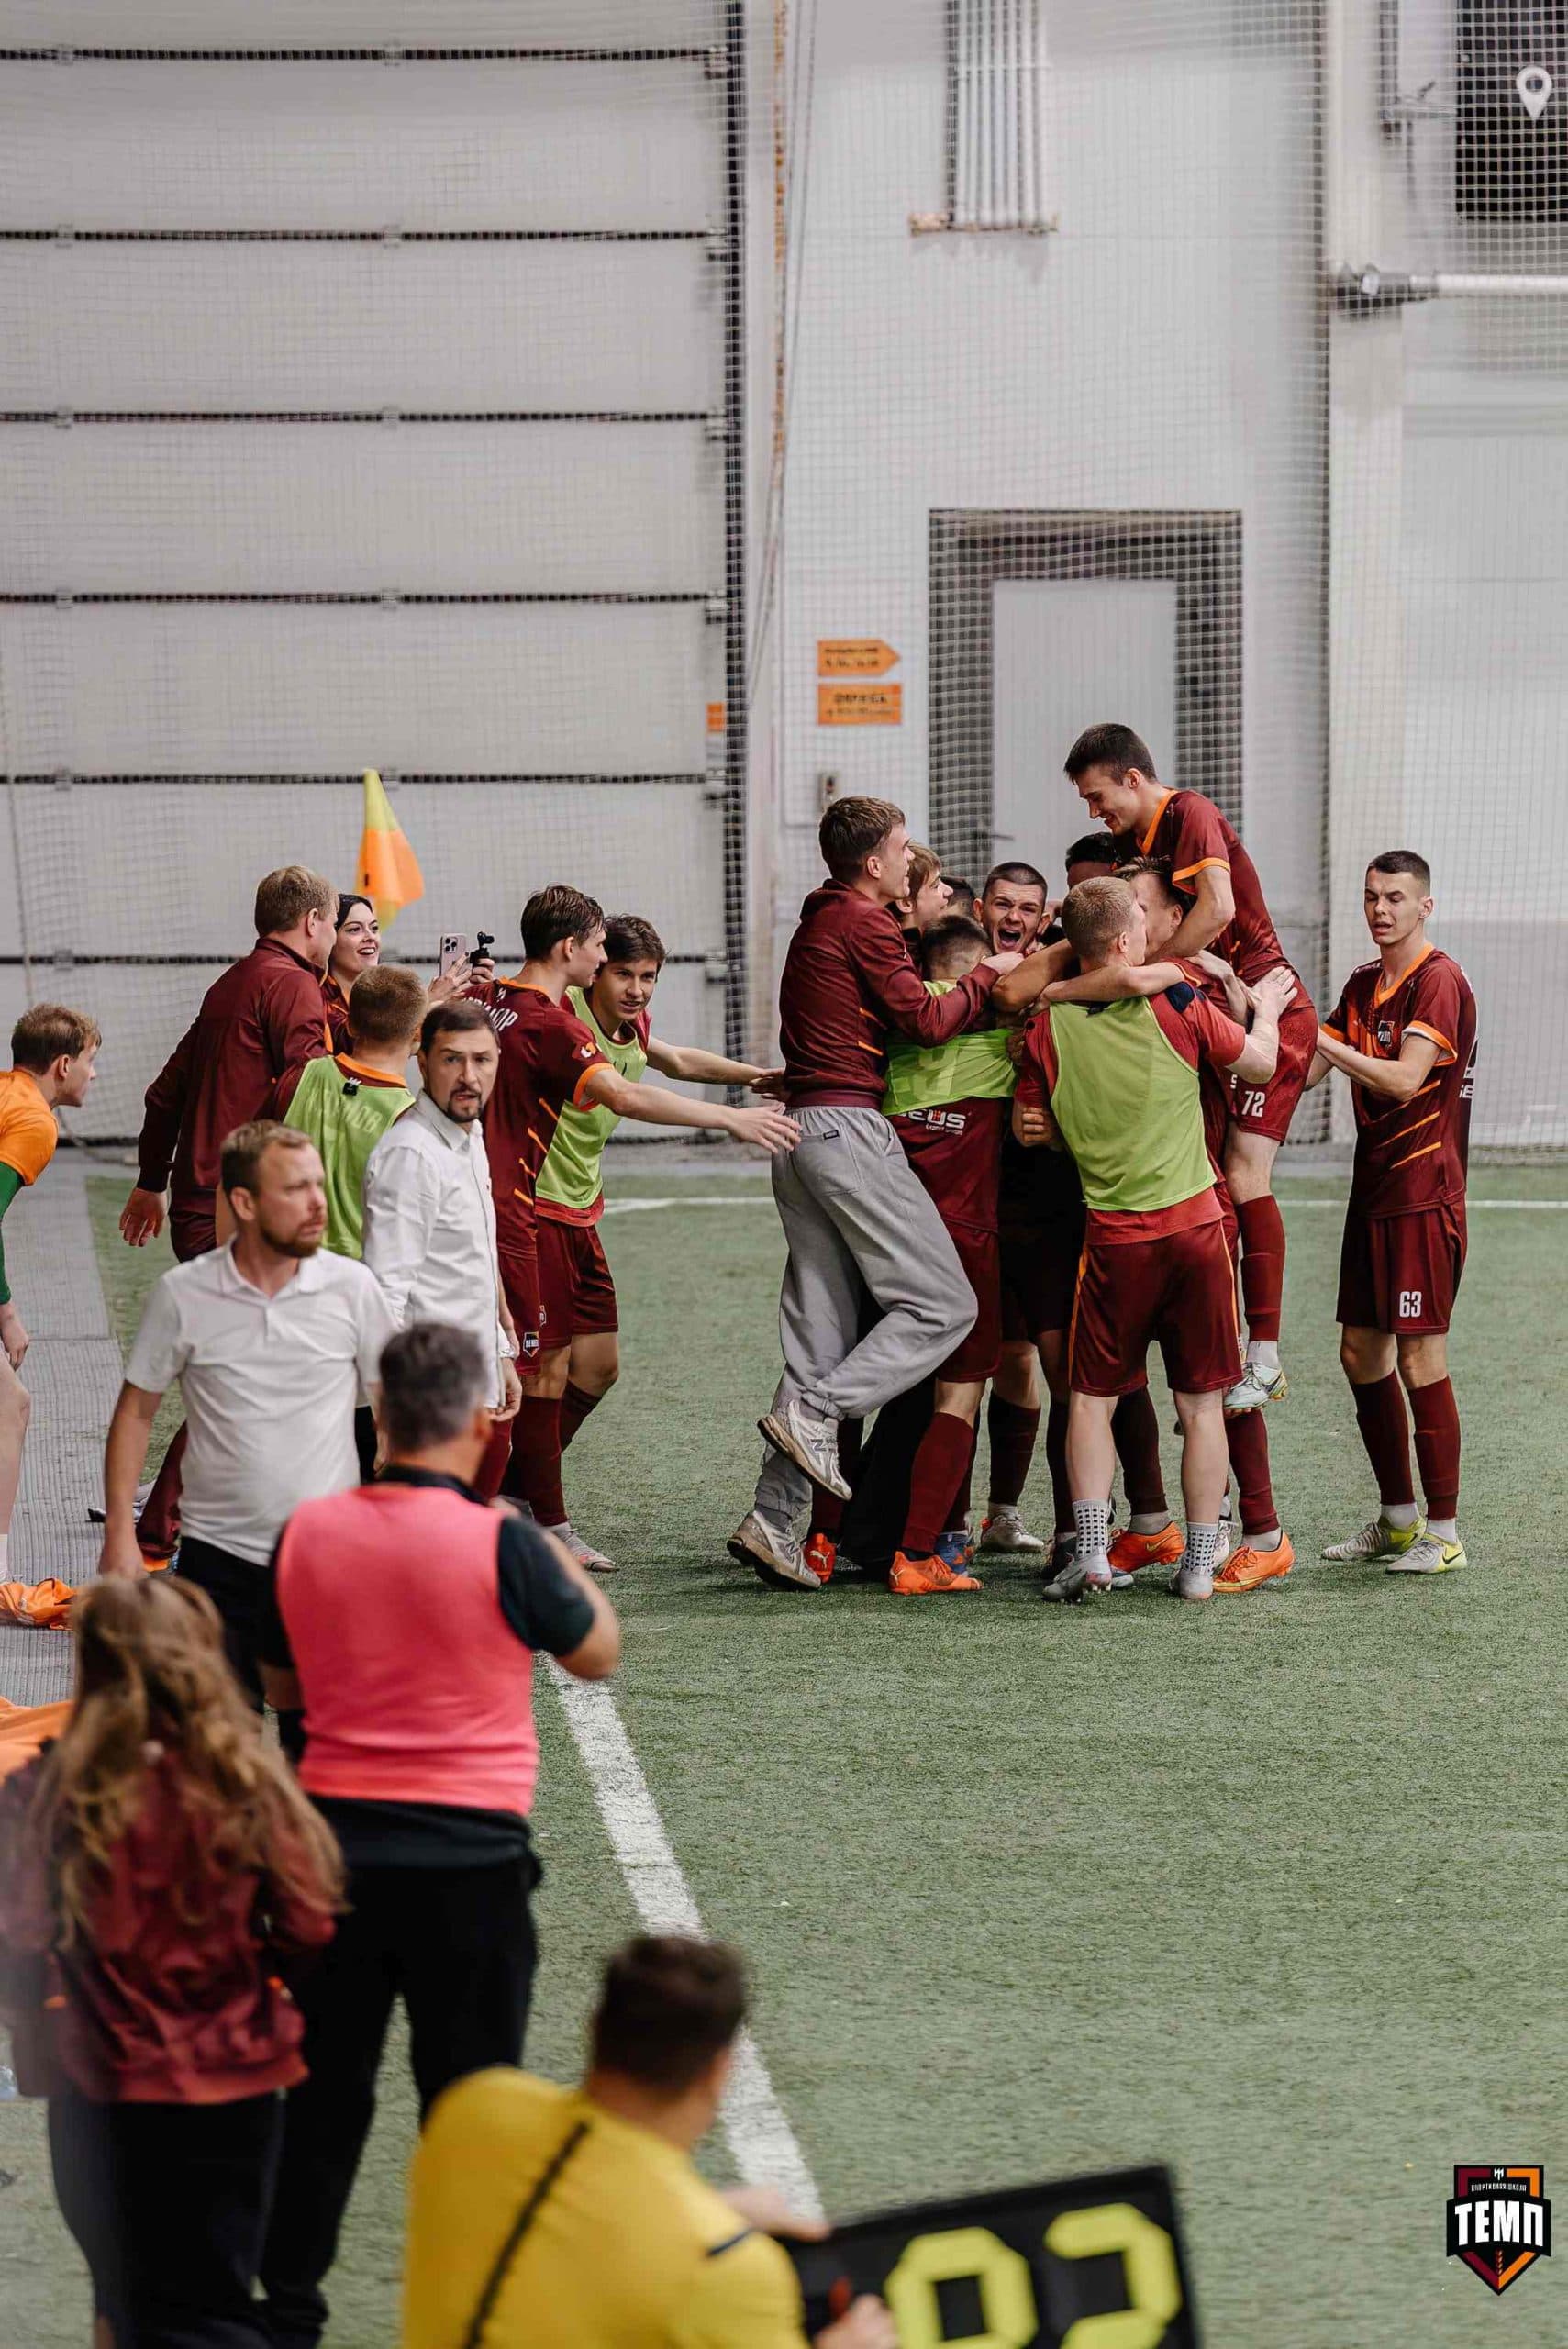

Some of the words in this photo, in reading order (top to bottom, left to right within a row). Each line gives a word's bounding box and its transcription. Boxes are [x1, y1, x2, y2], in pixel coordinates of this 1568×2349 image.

[1241, 1090, 1265, 1117] 72
[898, 1108, 966, 1130] EUS
[1399, 1291, 1422, 1318] 63
